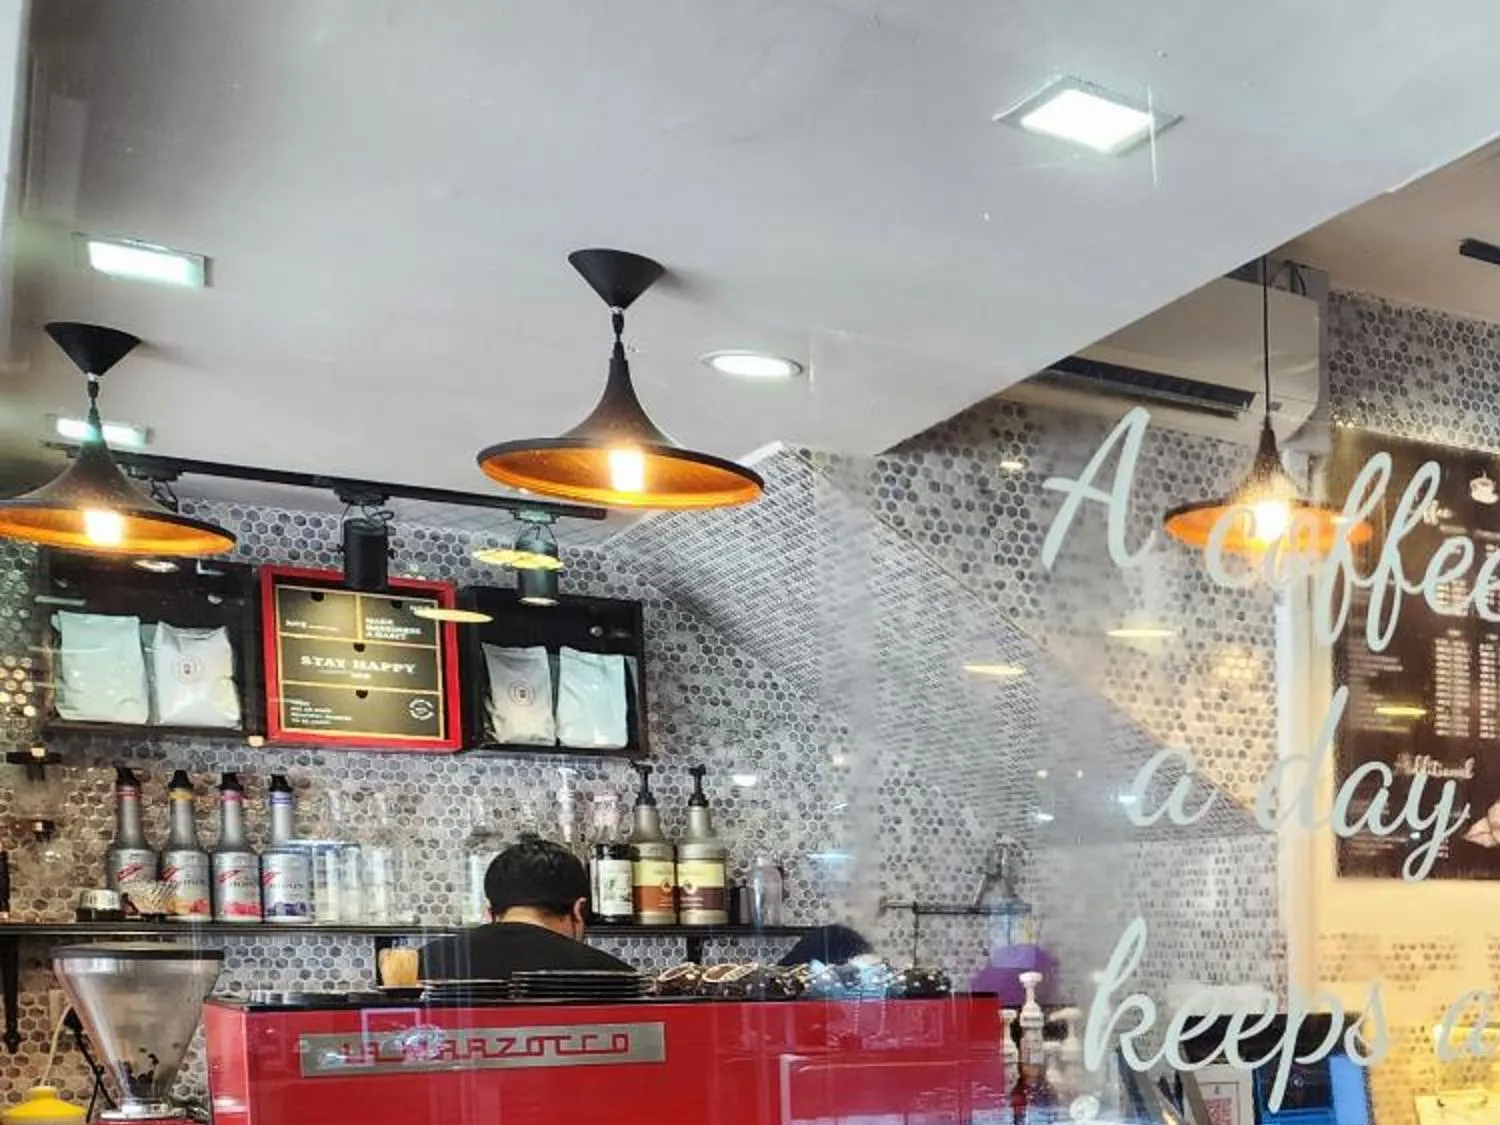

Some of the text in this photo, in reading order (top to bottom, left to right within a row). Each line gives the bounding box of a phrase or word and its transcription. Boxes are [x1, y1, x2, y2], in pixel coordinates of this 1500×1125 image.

[1041, 406, 1157, 571] A
[301, 655, 346, 670] STAY
[352, 659, 417, 675] HAPPY
[1122, 746, 1217, 826] a
[1256, 686, 1470, 882] day
[1084, 916, 1390, 1114] keeps
